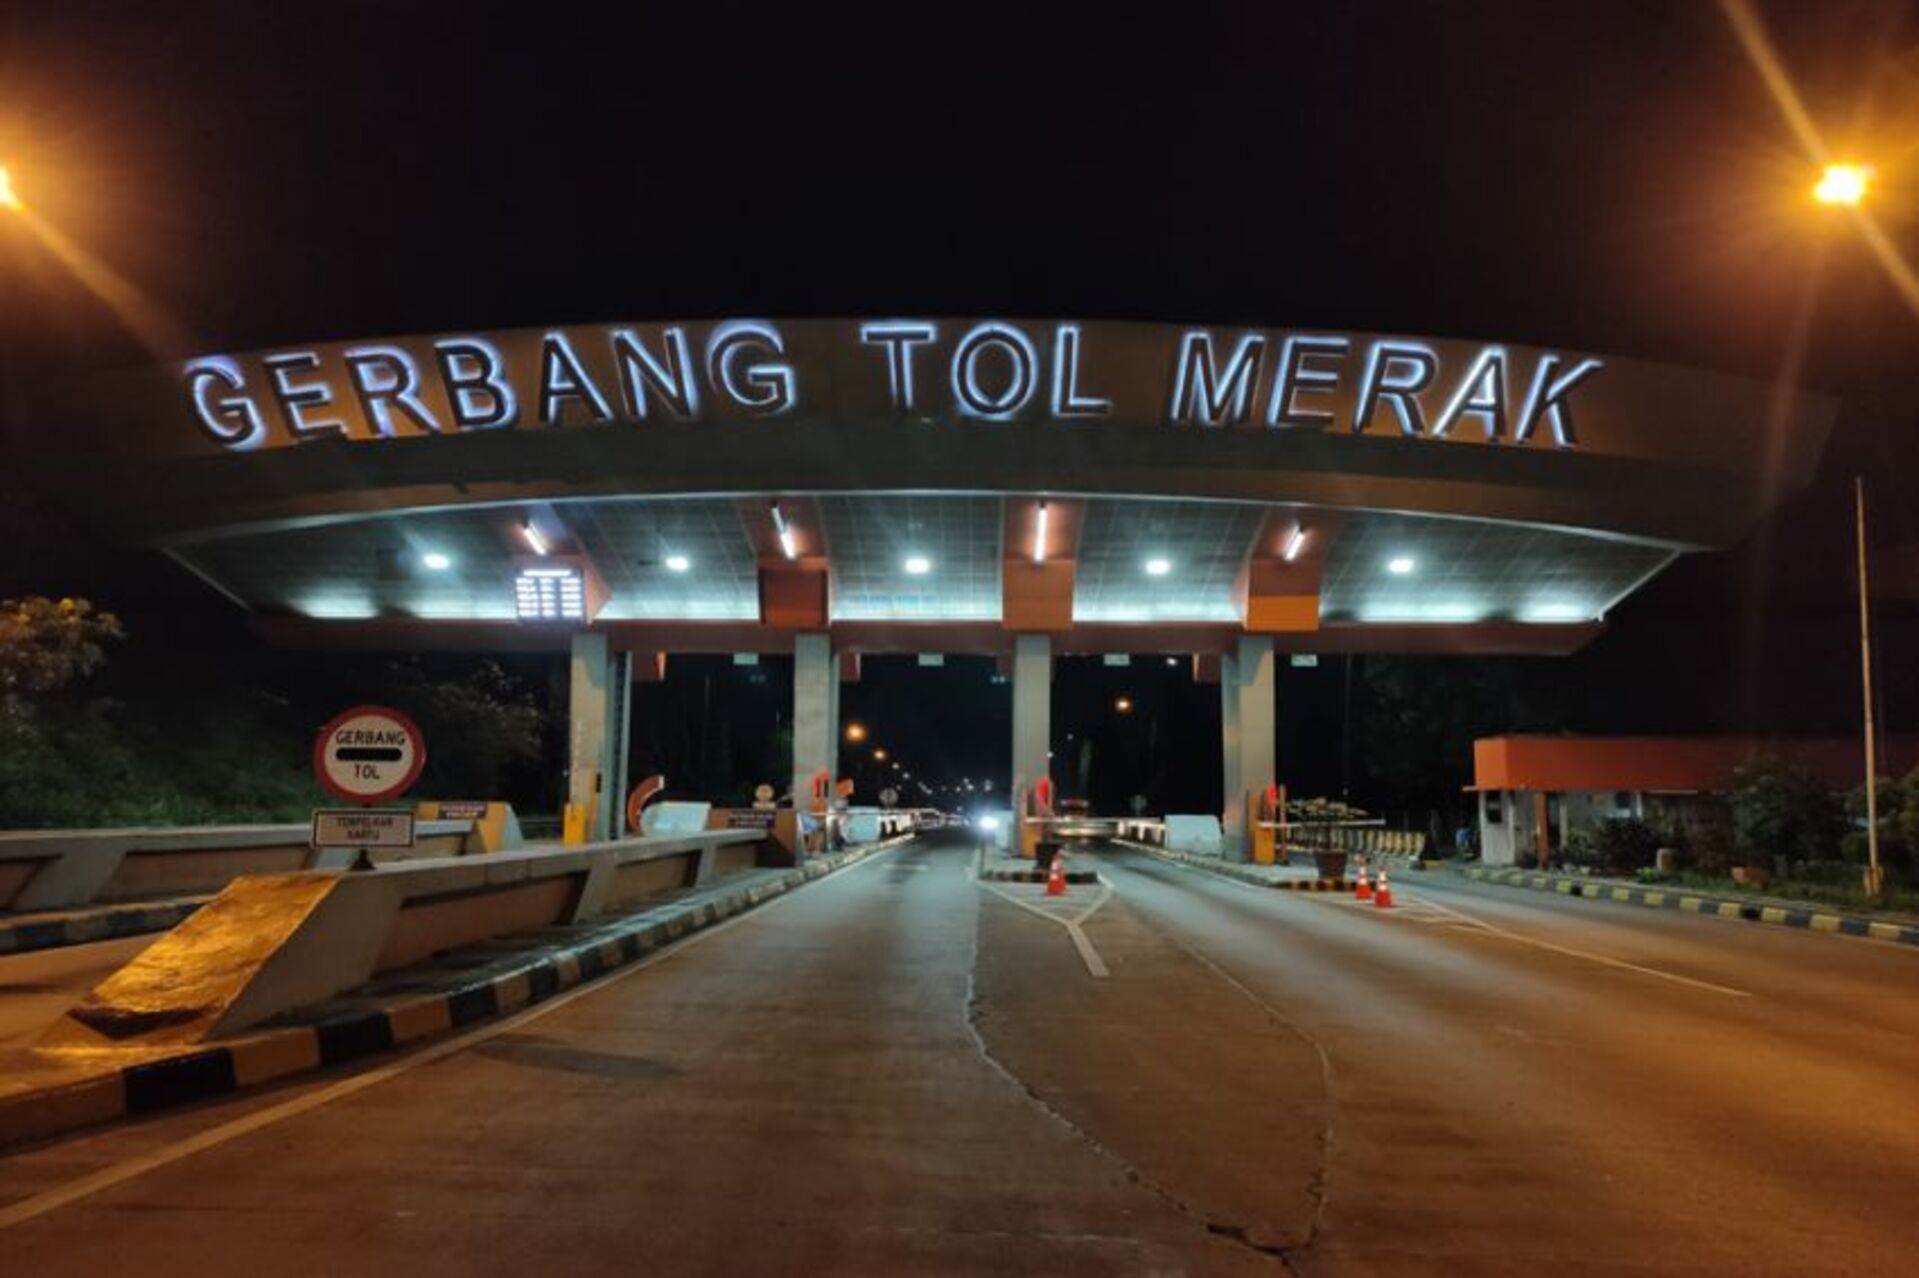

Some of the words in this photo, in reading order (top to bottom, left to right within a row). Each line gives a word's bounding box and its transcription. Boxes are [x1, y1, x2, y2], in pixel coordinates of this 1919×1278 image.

[184, 320, 796, 451] GERBANG
[860, 320, 1112, 421] TOL
[1168, 329, 1605, 450] MERAK
[335, 729, 405, 746] GERBANG
[354, 763, 381, 780] TOL
